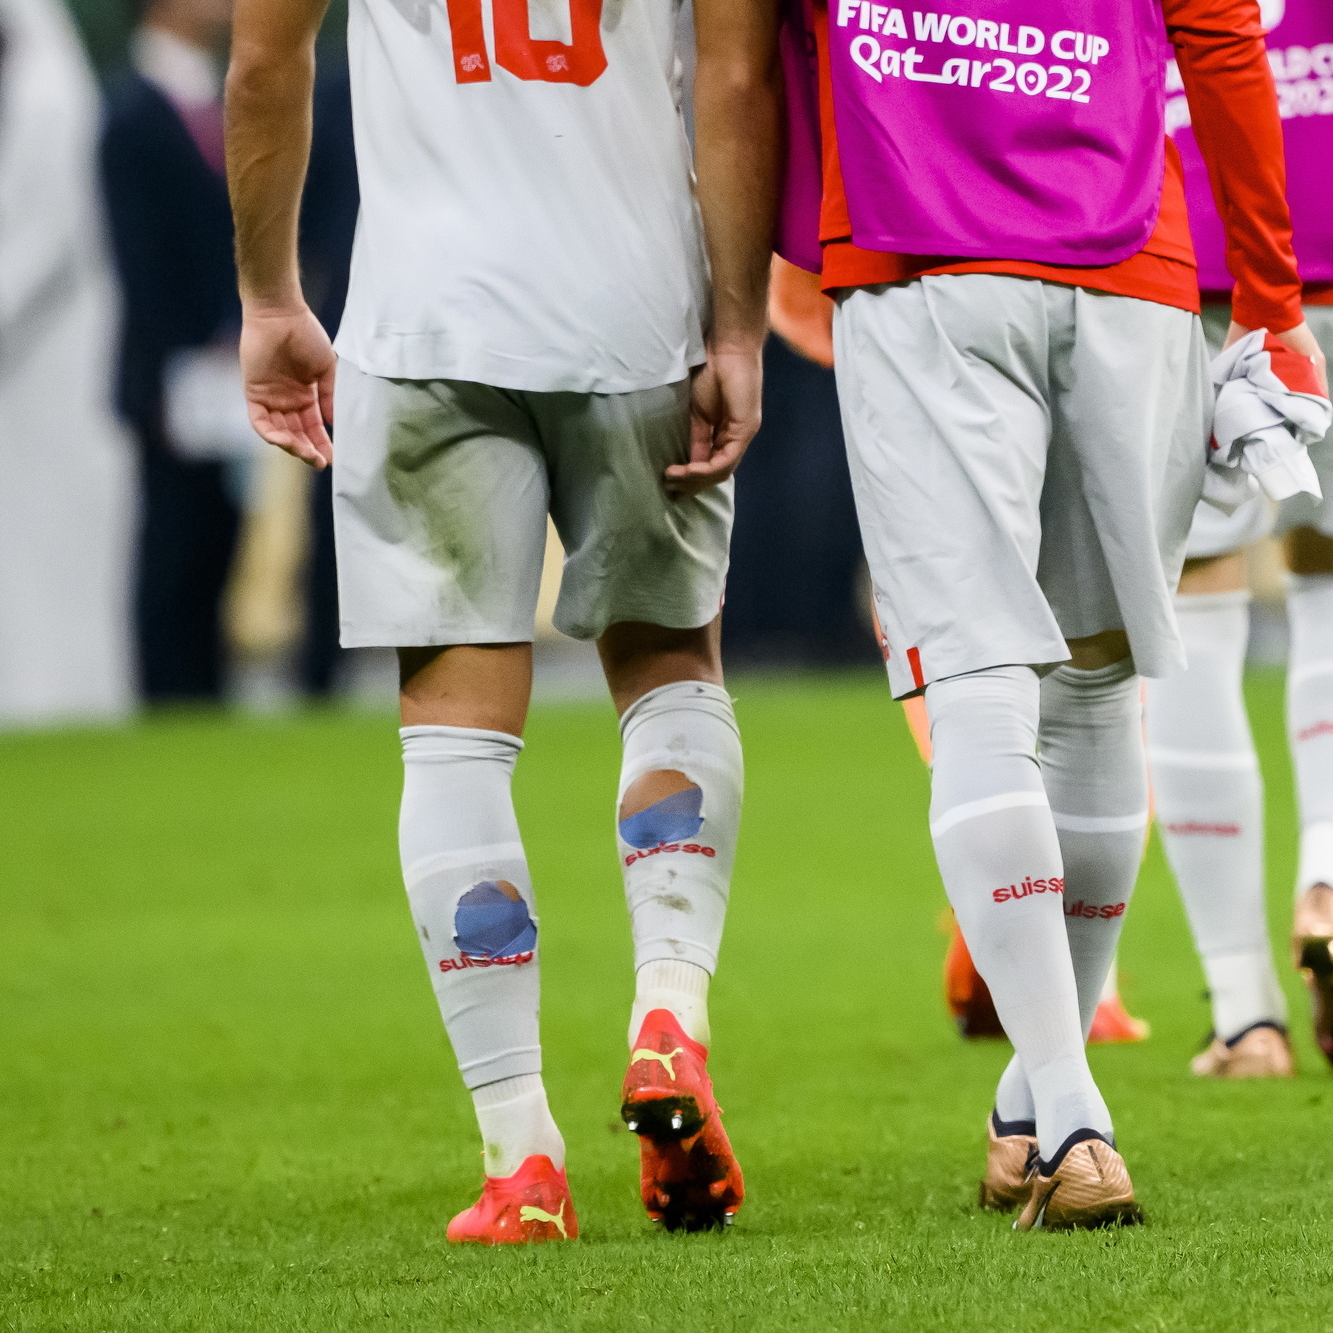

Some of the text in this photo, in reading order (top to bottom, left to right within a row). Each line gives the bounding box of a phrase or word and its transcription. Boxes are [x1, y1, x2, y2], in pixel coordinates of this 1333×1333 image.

[912, 11, 1046, 56] WORLD
[1050, 30, 1110, 65] CUP
[1064, 900, 1126, 919] uisse
